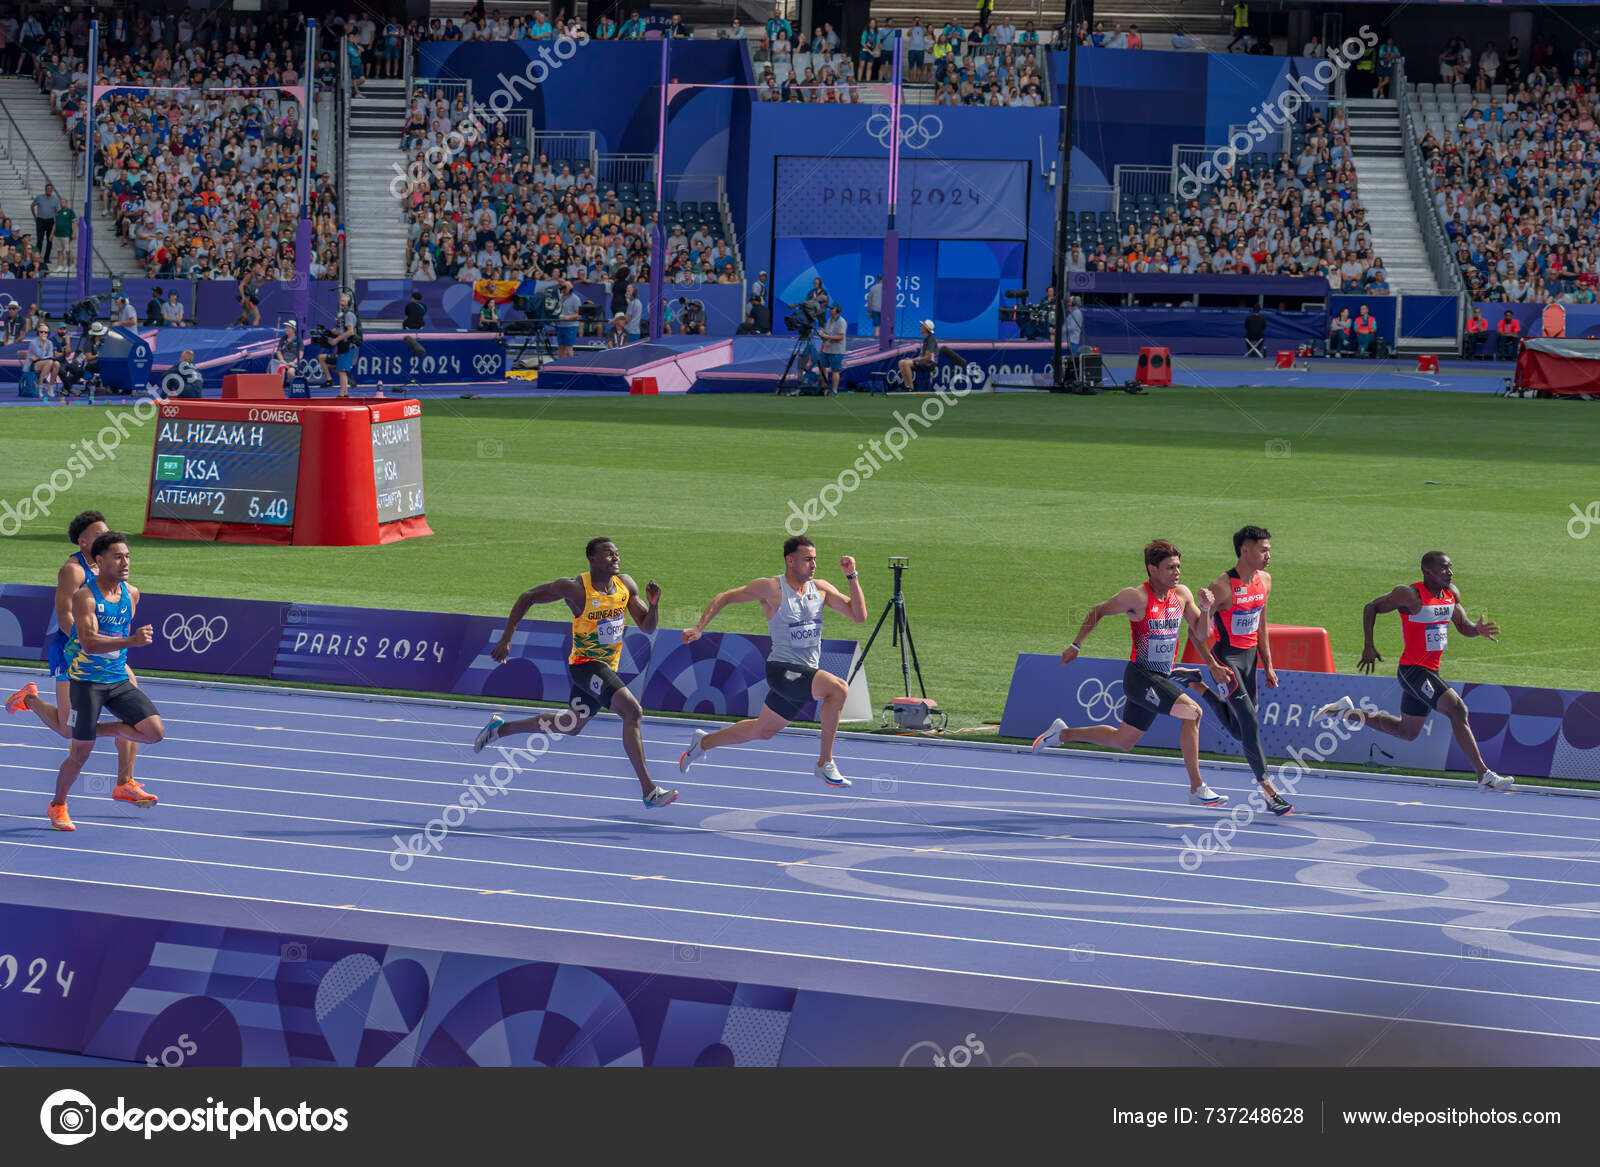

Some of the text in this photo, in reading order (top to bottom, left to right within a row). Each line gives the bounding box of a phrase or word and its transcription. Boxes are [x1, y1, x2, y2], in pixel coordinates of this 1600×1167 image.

[823, 187, 980, 206] PARI 2024
[864, 275, 920, 290] PRIS
[357, 355, 461, 375] ARIS 2024
[260, 409, 299, 423] OMEGA
[158, 422, 264, 447] AL HIZAM H
[184, 459, 220, 481] KSA
[155, 489, 288, 519] ATTEMPT 2 5.40
[588, 608, 612, 620] GUINEA
[1434, 607, 1450, 617] GAM
[293, 632, 444, 663] PARIS 2024
[0, 954, 75, 998] 024
